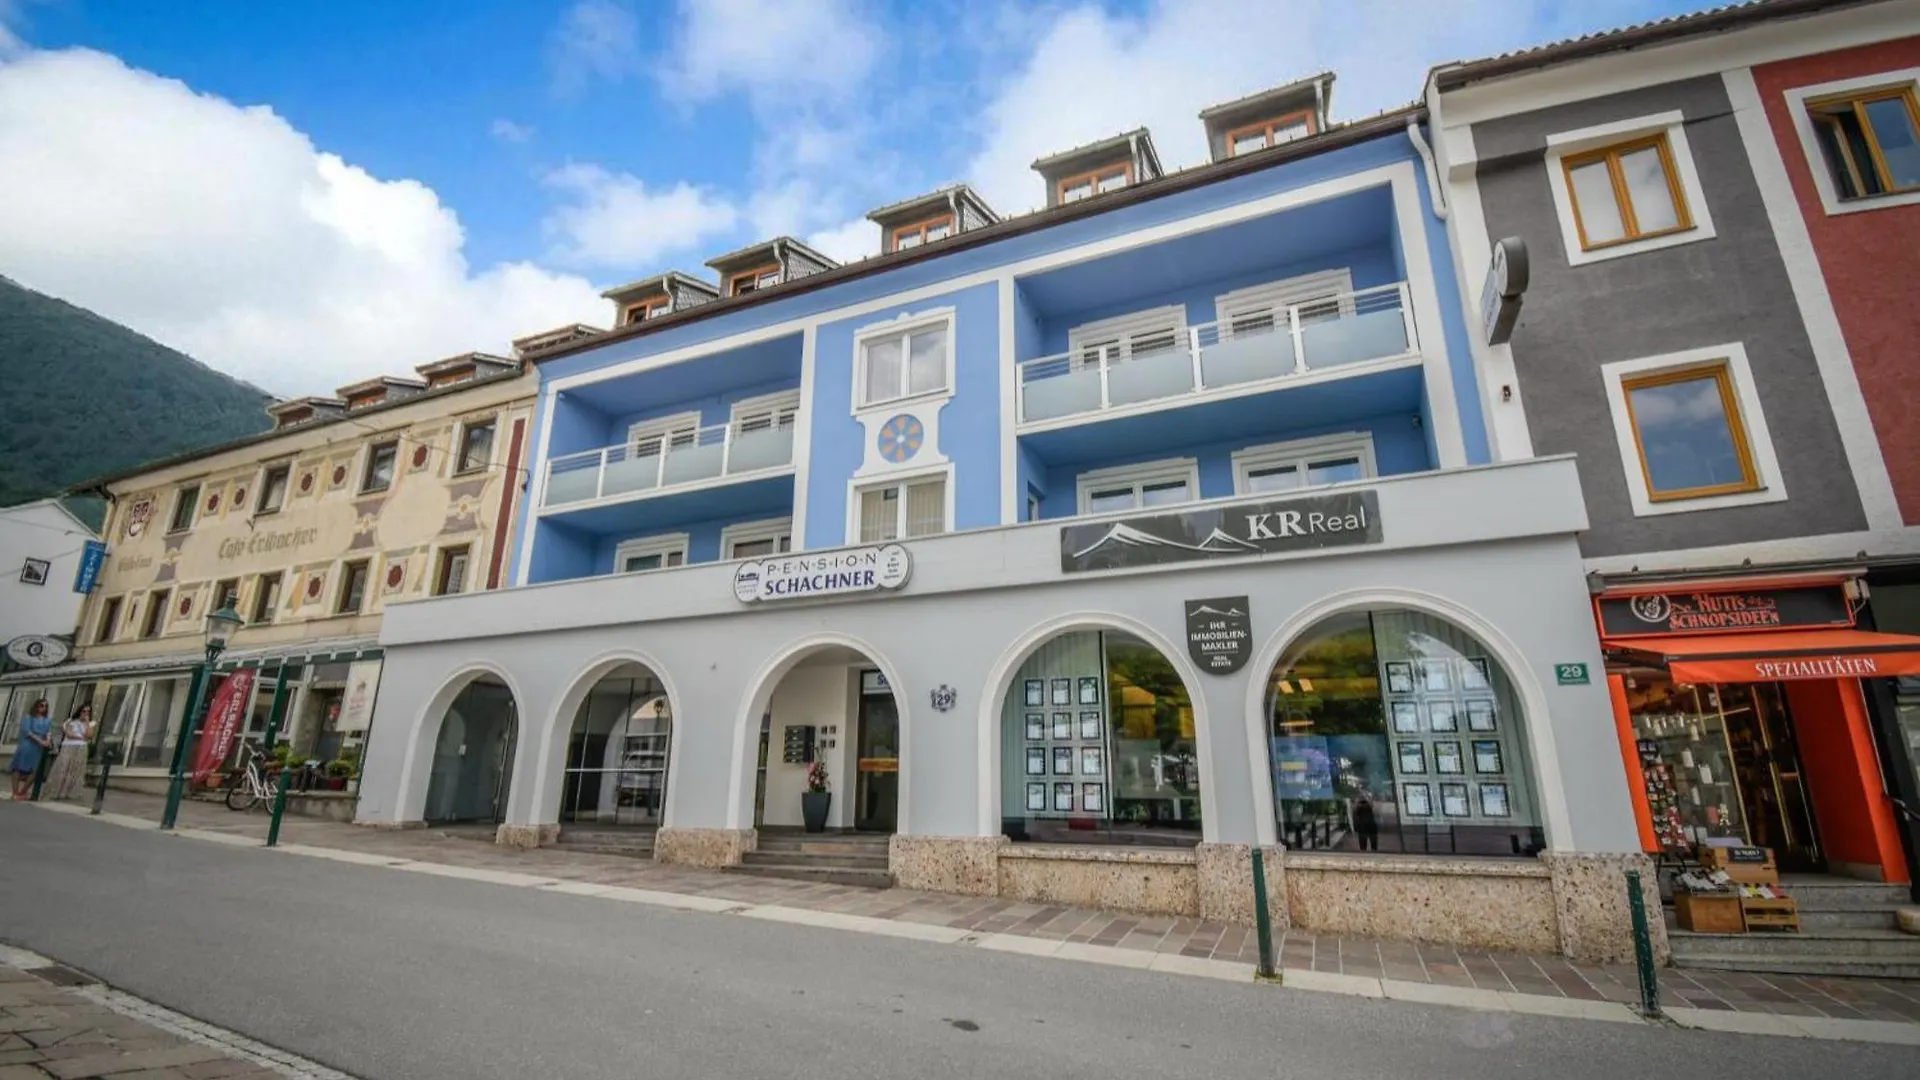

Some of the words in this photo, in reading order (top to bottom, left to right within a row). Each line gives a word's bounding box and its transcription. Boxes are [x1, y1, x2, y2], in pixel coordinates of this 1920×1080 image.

[1245, 510, 1307, 540] KR
[1308, 504, 1367, 533] Real
[764, 570, 875, 595] SCHACHNER
[1561, 666, 1583, 678] 29
[1755, 655, 1877, 679] SPEZIALITÄTEN
[937, 693, 951, 706] 29
